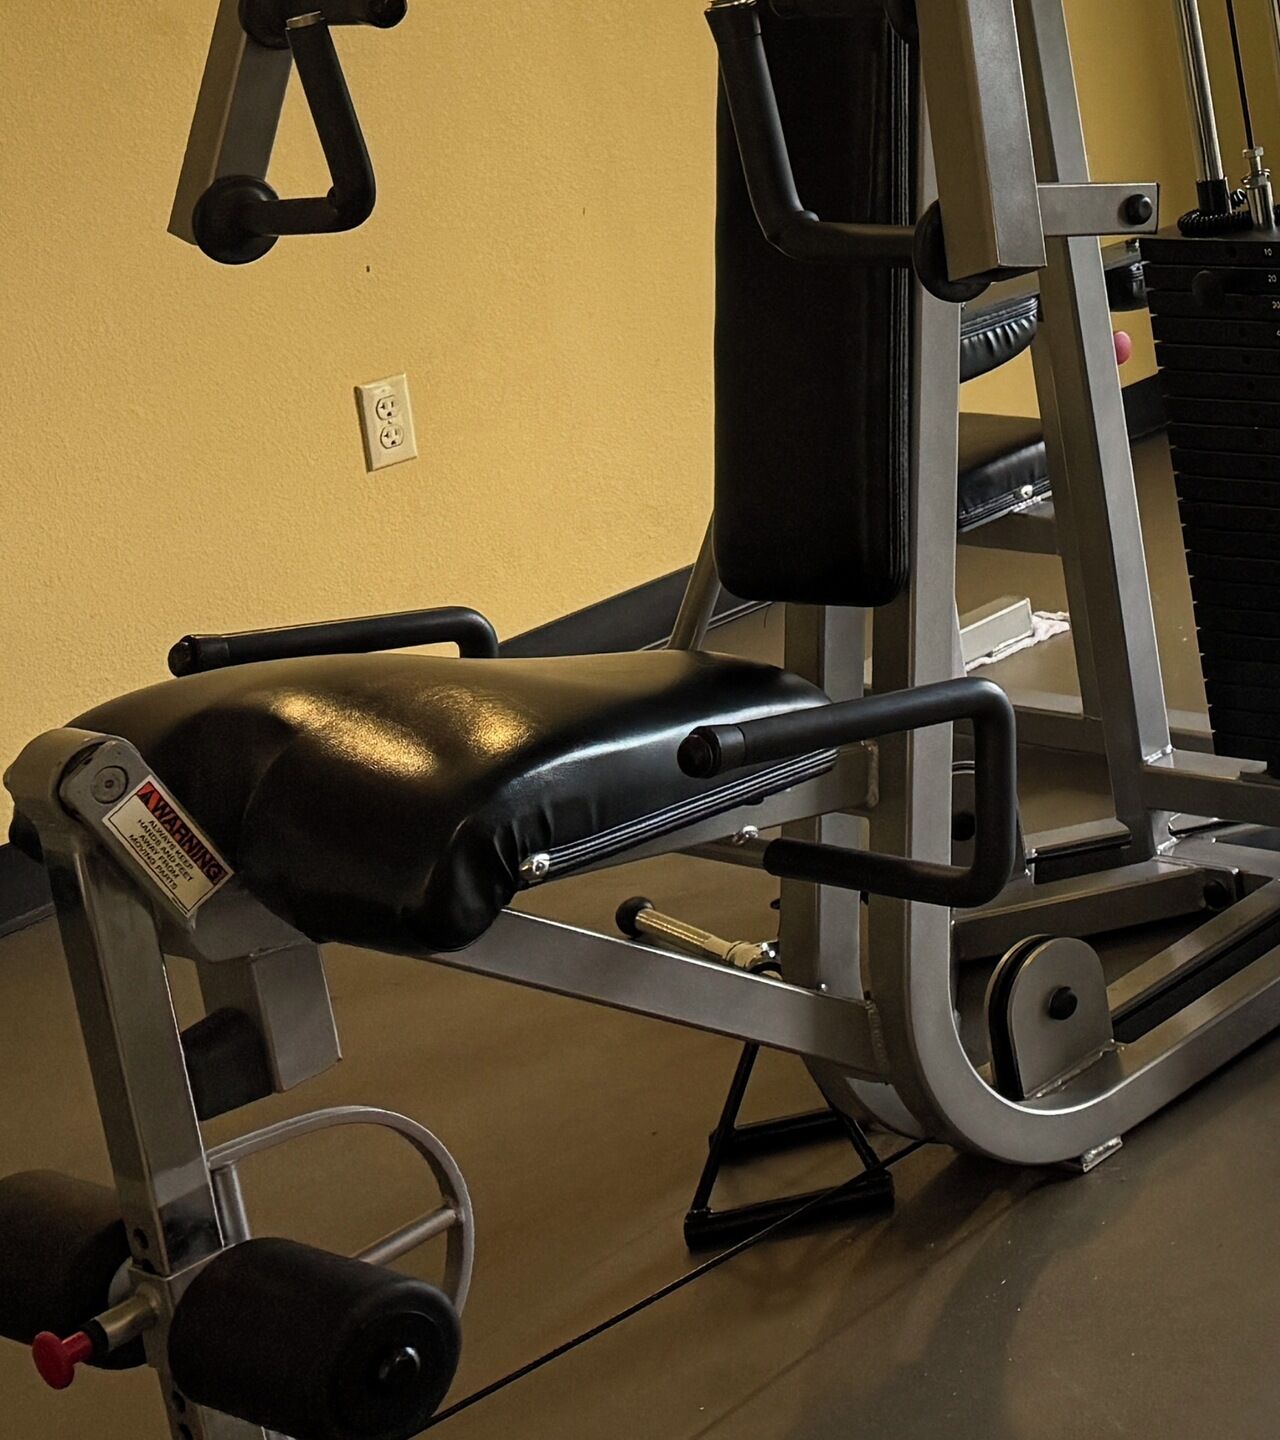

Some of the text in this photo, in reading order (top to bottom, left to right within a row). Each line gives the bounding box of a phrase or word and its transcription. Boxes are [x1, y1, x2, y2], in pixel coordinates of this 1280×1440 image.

[128, 834, 178, 890] MOVING PARTS
[138, 819, 161, 846] HANDS
[160, 846, 176, 863] AND
[175, 863, 193, 882] FEET
[139, 834, 179, 879] AWAY FROM
[149, 820, 175, 850] ALWAYS
[176, 849, 194, 870] KEEP
[153, 801, 225, 884] WARNING
